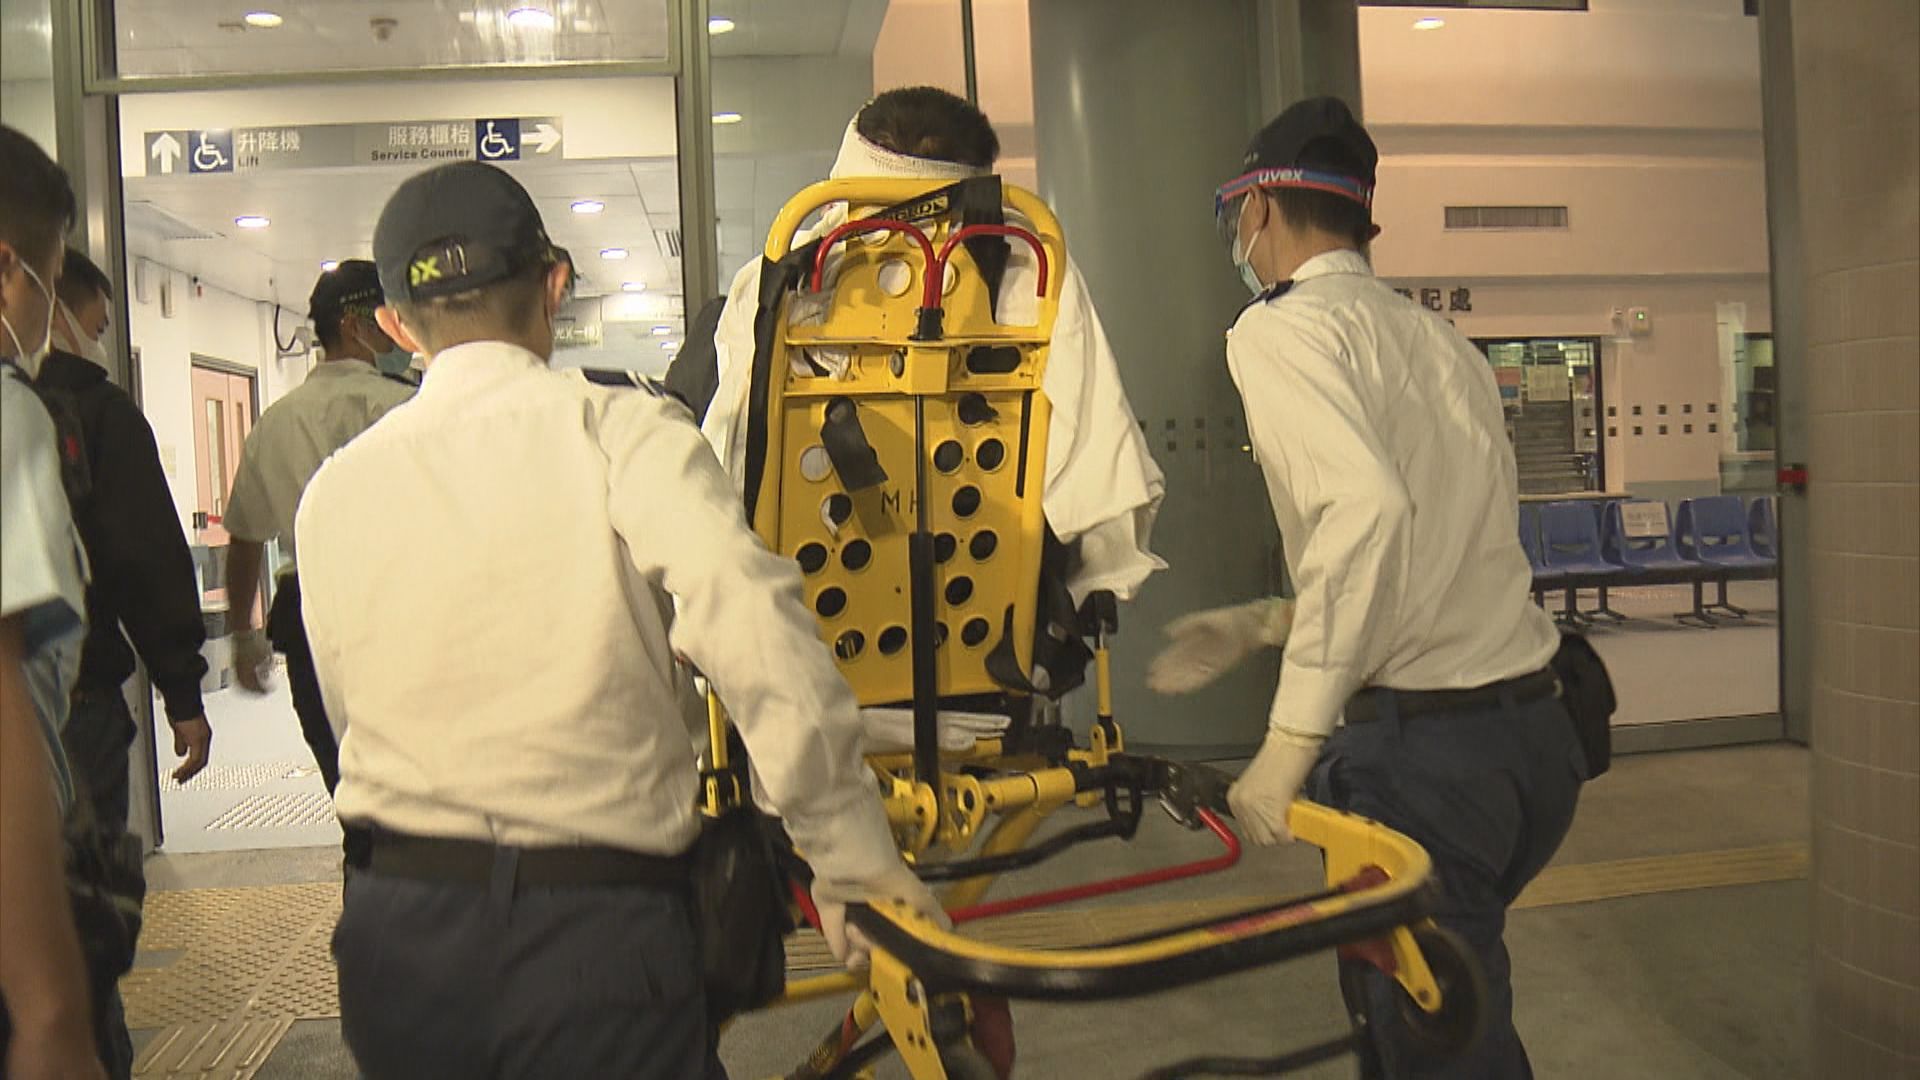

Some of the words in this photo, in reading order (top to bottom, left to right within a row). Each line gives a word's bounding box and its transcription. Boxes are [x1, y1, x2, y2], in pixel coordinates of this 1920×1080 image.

[238, 131, 301, 153] 升降機
[238, 155, 260, 167] Lift
[371, 150, 418, 162] Service
[421, 148, 472, 160] Counter
[1258, 168, 1305, 184] uvex
